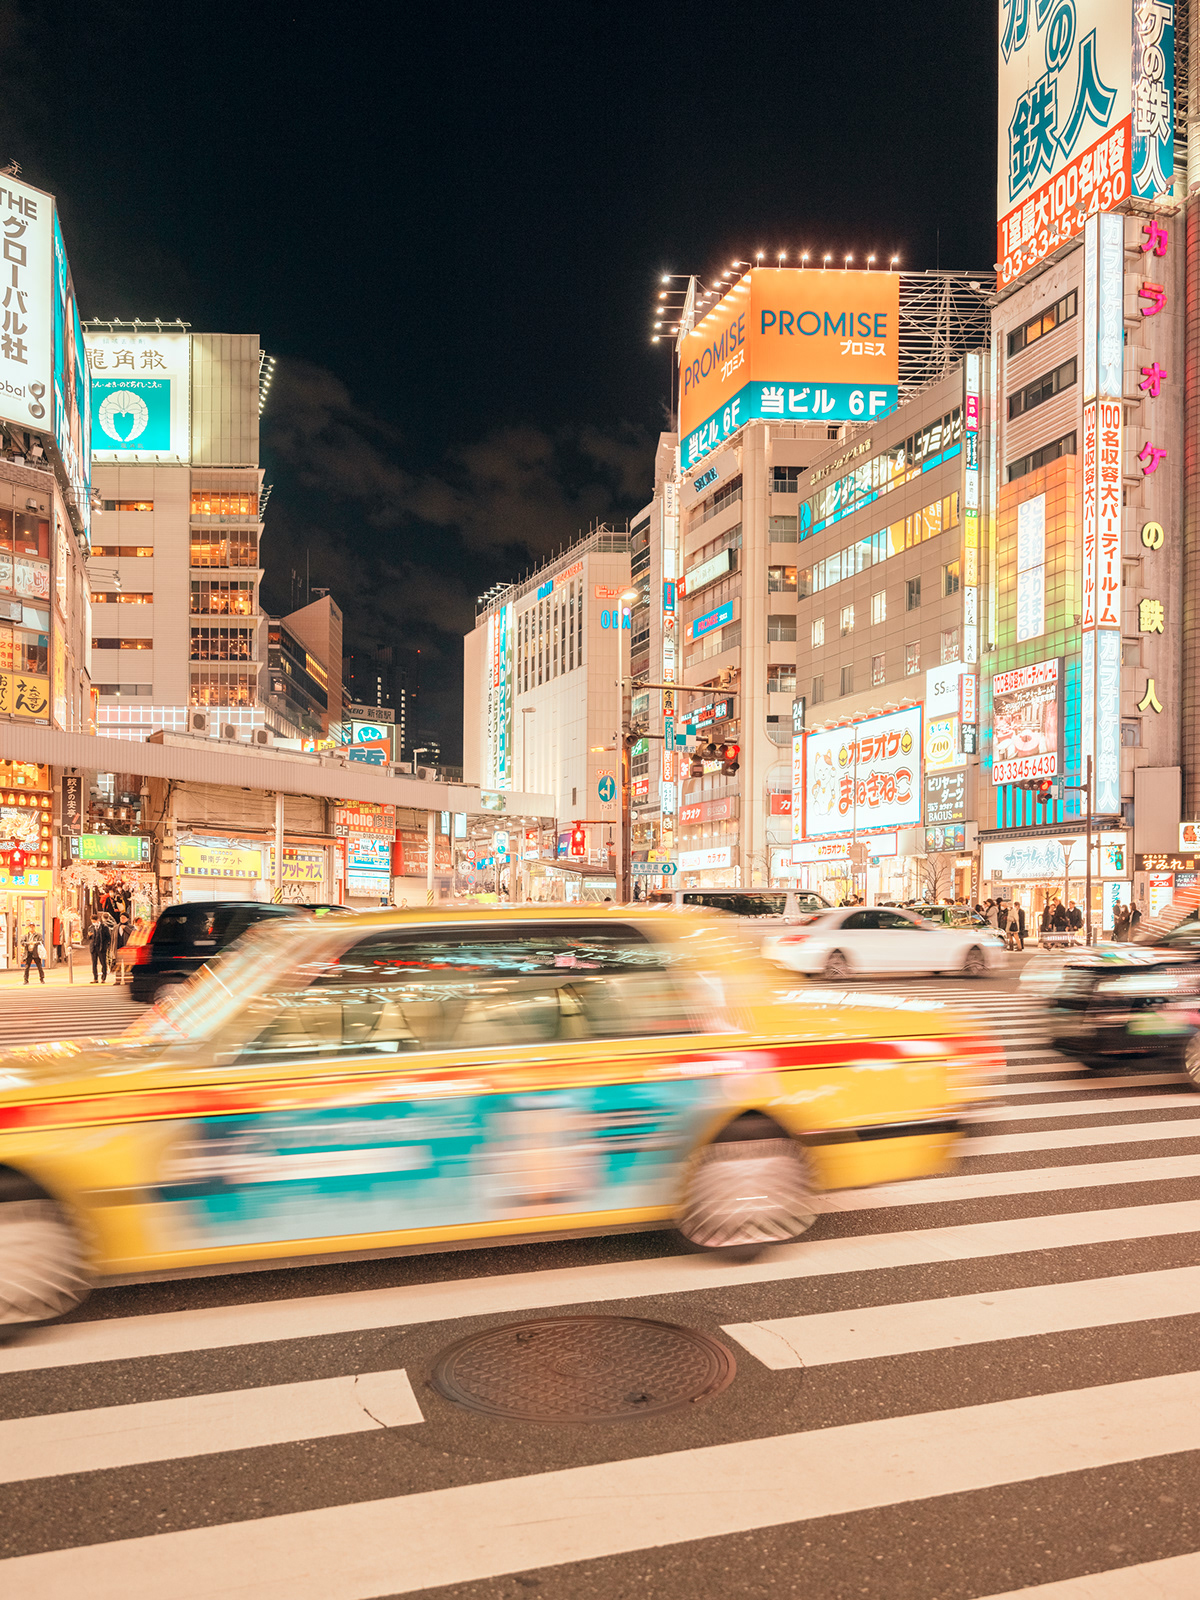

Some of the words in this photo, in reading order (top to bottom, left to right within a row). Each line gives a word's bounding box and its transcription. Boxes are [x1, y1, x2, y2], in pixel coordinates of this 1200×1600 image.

[1002, 128, 1125, 257] 1室最大100名収容
[1, 215, 28, 365] グローバル社
[1102, 216, 1121, 395] カラオケの鉄人
[761, 309, 887, 338] PROMISE
[684, 311, 746, 395] PROMISE
[840, 340, 887, 356] プロミス
[85, 348, 167, 370] 龍角散
[721, 349, 745, 382] プロミス
[761, 386, 835, 414] 当ビル
[849, 390, 887, 416] 6F
[688, 421, 718, 461] 当ビル
[723, 397, 741, 432] 6F
[1083, 405, 1095, 626] 100名収容大パーティールーム
[1101, 404, 1120, 624] 100名収容大パーティールーム
[934, 681, 946, 696] SS
[964, 677, 974, 719] カラオケ
[367, 708, 392, 720] 新宿駅
[793, 702, 802, 719] 24
[1099, 631, 1118, 810] カラオケの鉄人
[794, 721, 801, 731] H
[848, 732, 901, 765] カラオケ
[838, 766, 913, 815] まねきねこ
[928, 773, 964, 791] ビリヤード
[941, 787, 964, 803] ダーツ
[682, 808, 700, 820] カラオケ
[928, 810, 953, 822] BAGUS
[336, 825, 349, 836] 2F
[83, 838, 138, 858] 思い出横丁
[707, 853, 726, 863] カラオケ
[822, 844, 841, 854] カラオケ
[200, 855, 242, 865] 甲南チケット
[306, 862, 323, 878] オズ
[1142, 859, 1185, 870] すみれ
